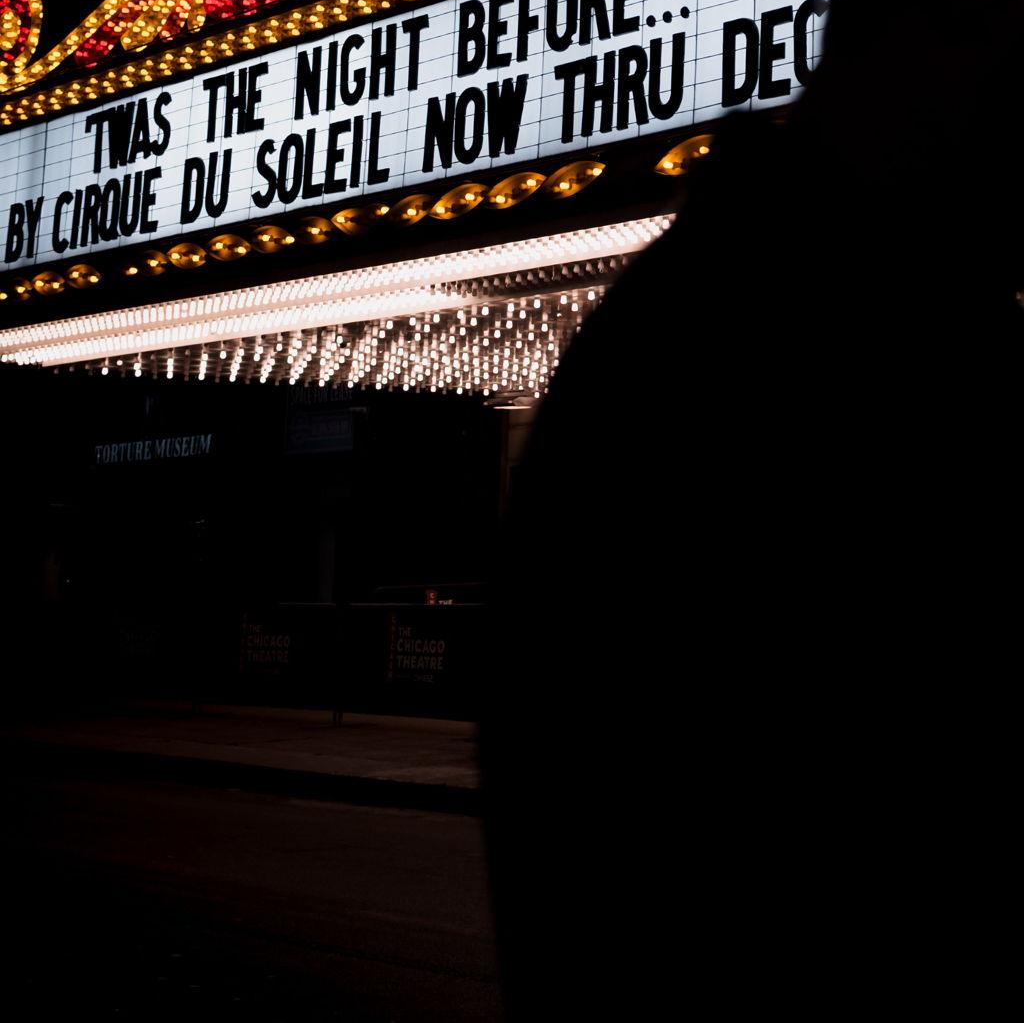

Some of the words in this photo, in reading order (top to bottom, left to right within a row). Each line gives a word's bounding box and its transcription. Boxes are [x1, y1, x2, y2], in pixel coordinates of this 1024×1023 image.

[203, 62, 268, 142] THE
[294, 14, 430, 120] NIGHT
[4, 196, 44, 263] BY
[52, 167, 162, 253] CIRQUE
[180, 149, 232, 225] DU
[251, 111, 390, 209] SOLEIL
[422, 73, 529, 172] NOW
[554, 31, 686, 144] THRU
[95, 440, 152, 464] TORTURE
[155, 433, 212, 459] MUSEUM
[398, 626, 412, 637] THE
[396, 639, 445, 654] CHICAGO
[396, 655, 443, 670] THEATRE
